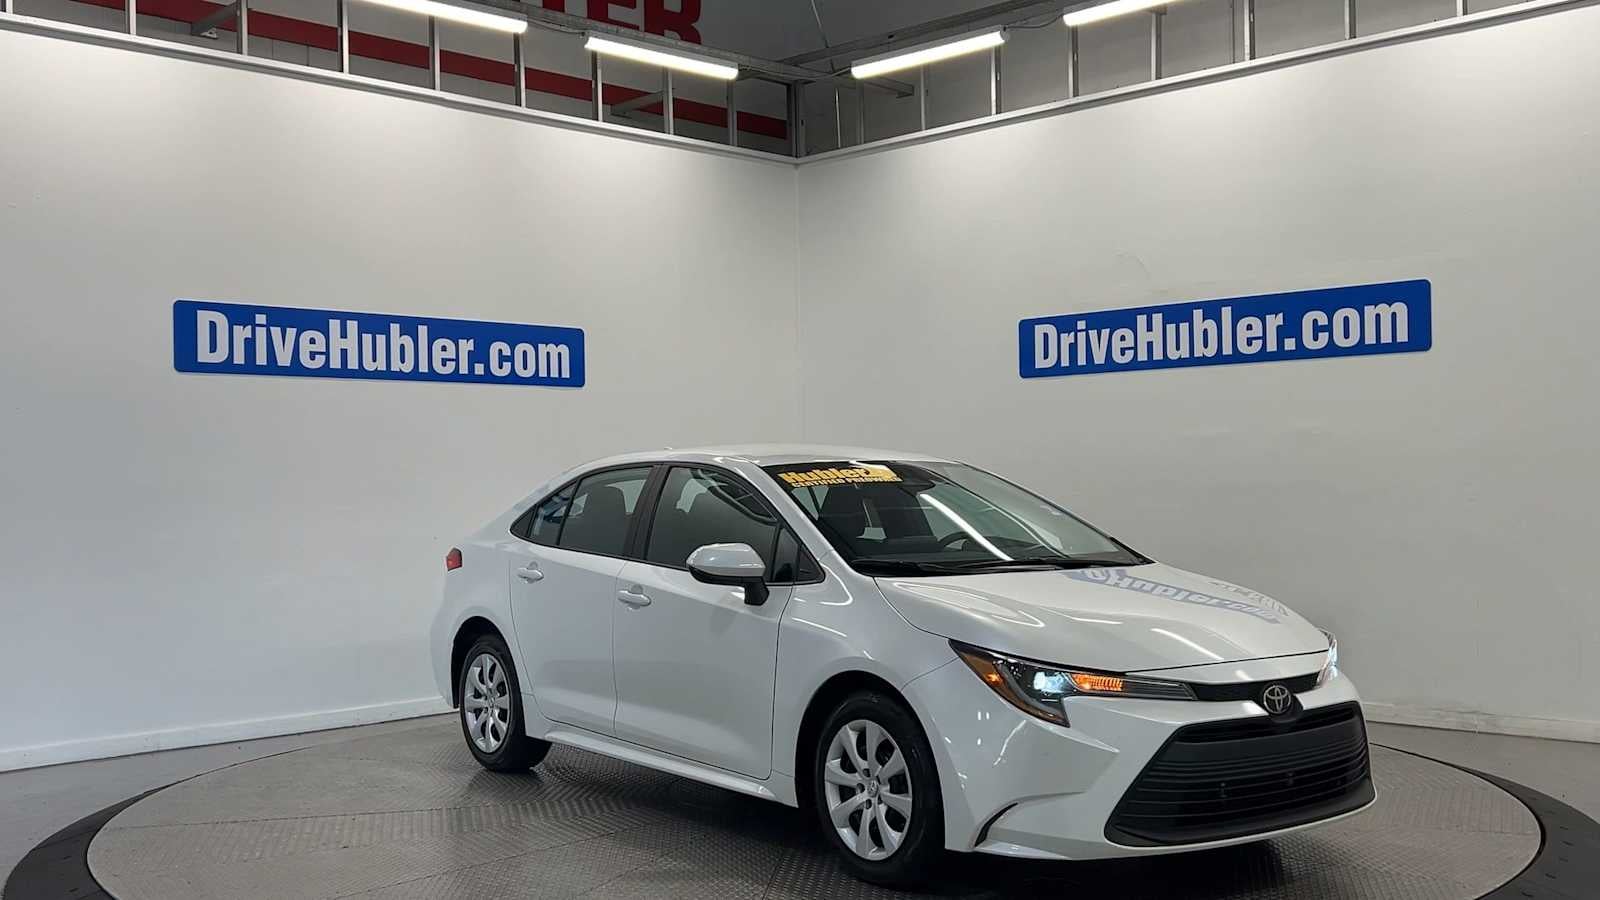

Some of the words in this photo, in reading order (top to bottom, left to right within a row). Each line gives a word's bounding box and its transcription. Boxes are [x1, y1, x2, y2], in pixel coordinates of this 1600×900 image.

[541, 0, 702, 45] ER
[196, 309, 571, 379] DriveHubler.com
[1034, 300, 1409, 369] DriveHubler.com
[776, 467, 870, 483] Hubler
